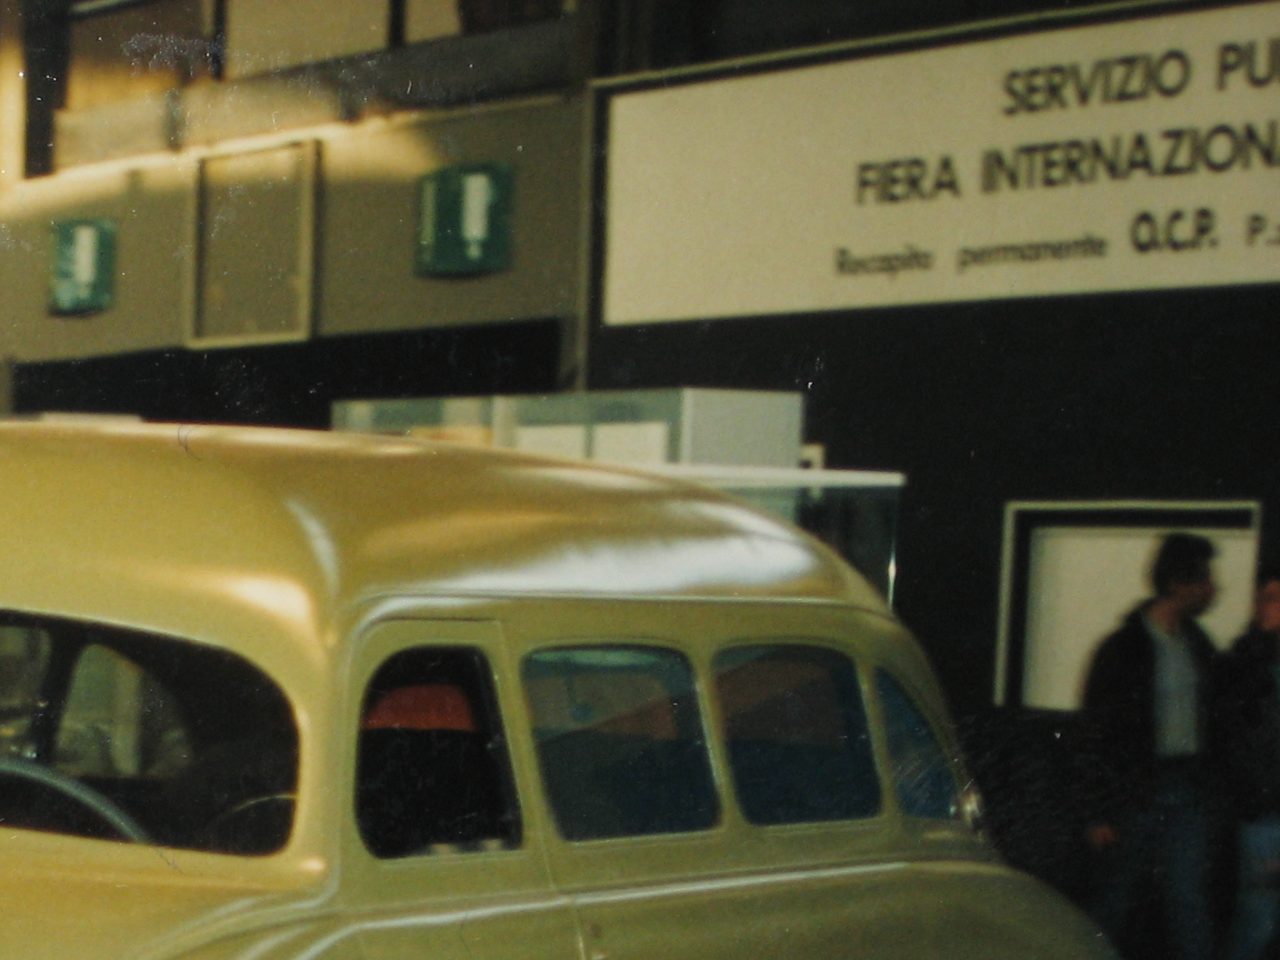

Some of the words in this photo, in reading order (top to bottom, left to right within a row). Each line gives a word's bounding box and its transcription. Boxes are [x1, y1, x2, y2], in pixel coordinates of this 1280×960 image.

[1003, 50, 1190, 115] SERVIZIO
[1214, 38, 1280, 91] PU
[855, 155, 961, 204] FIERA
[980, 120, 1280, 194] INTERNAZION
